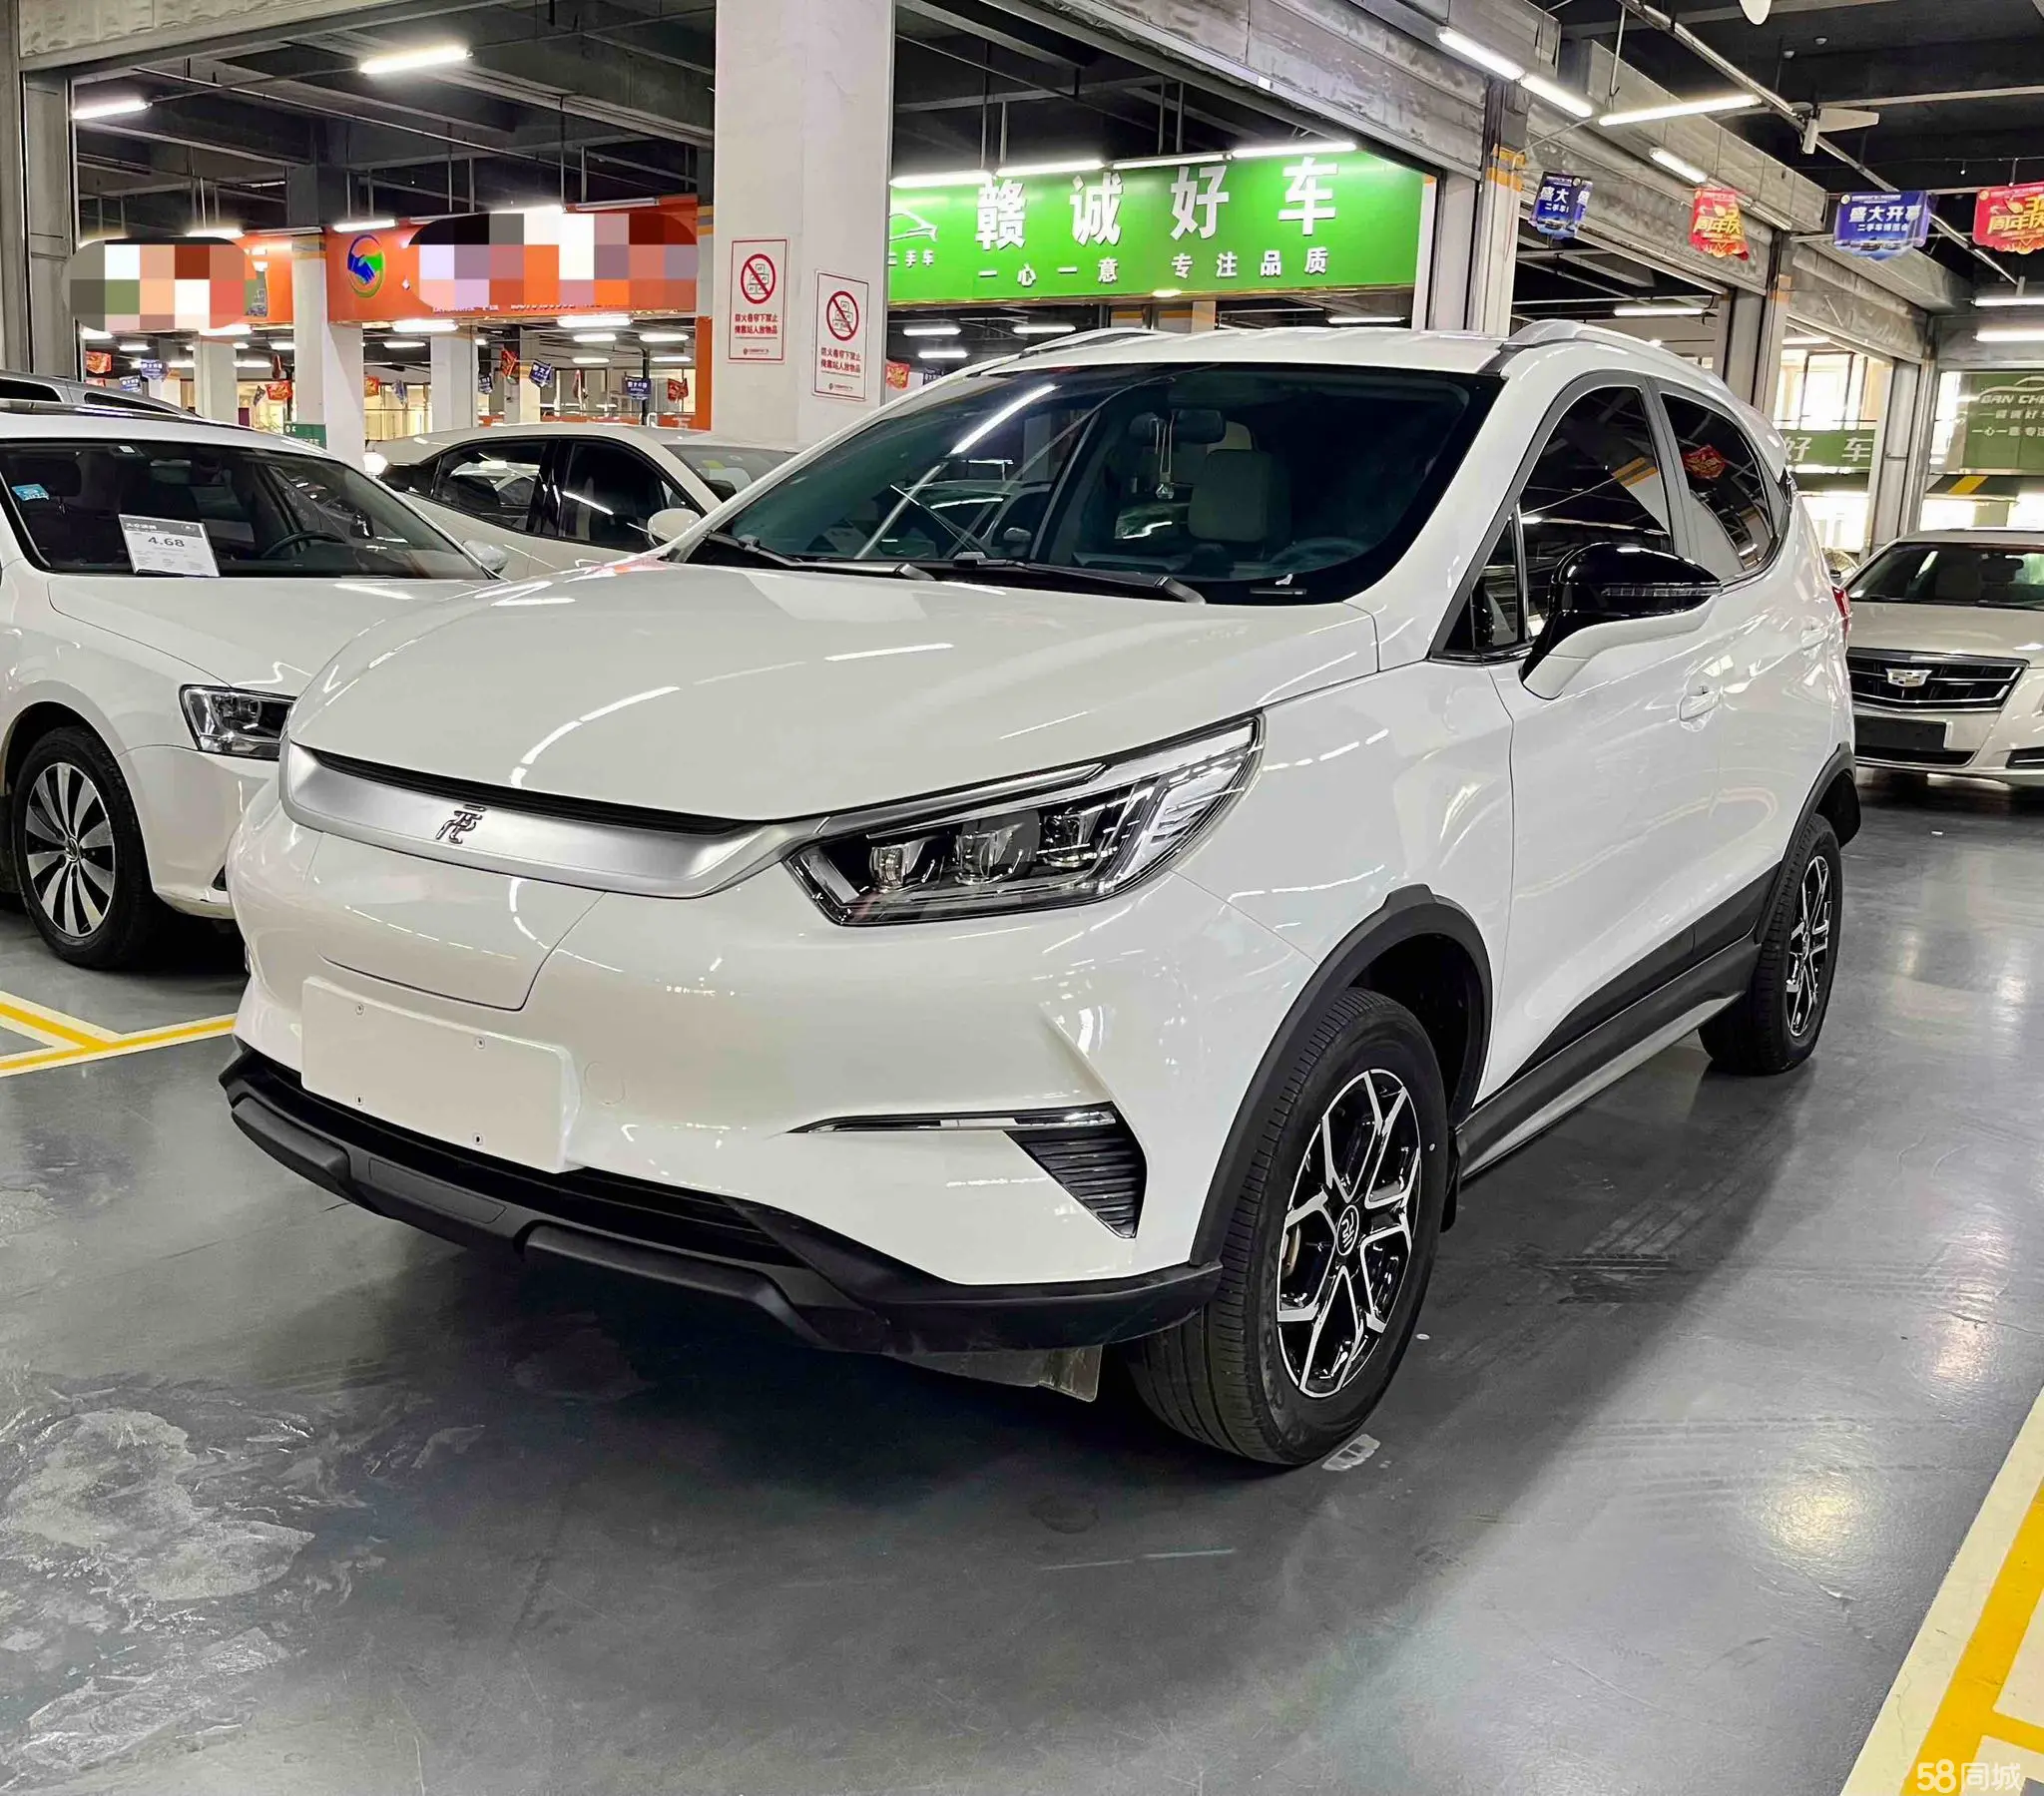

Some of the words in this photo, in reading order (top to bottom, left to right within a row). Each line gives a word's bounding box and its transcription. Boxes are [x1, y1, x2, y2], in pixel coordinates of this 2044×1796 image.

[976, 156, 1338, 250] 赣诚好车
[1544, 203, 1570, 213] 二手车
[978, 257, 1119, 286] 一心一意
[1171, 247, 1328, 279] 专注品质
[148, 537, 185, 548] 4.68
